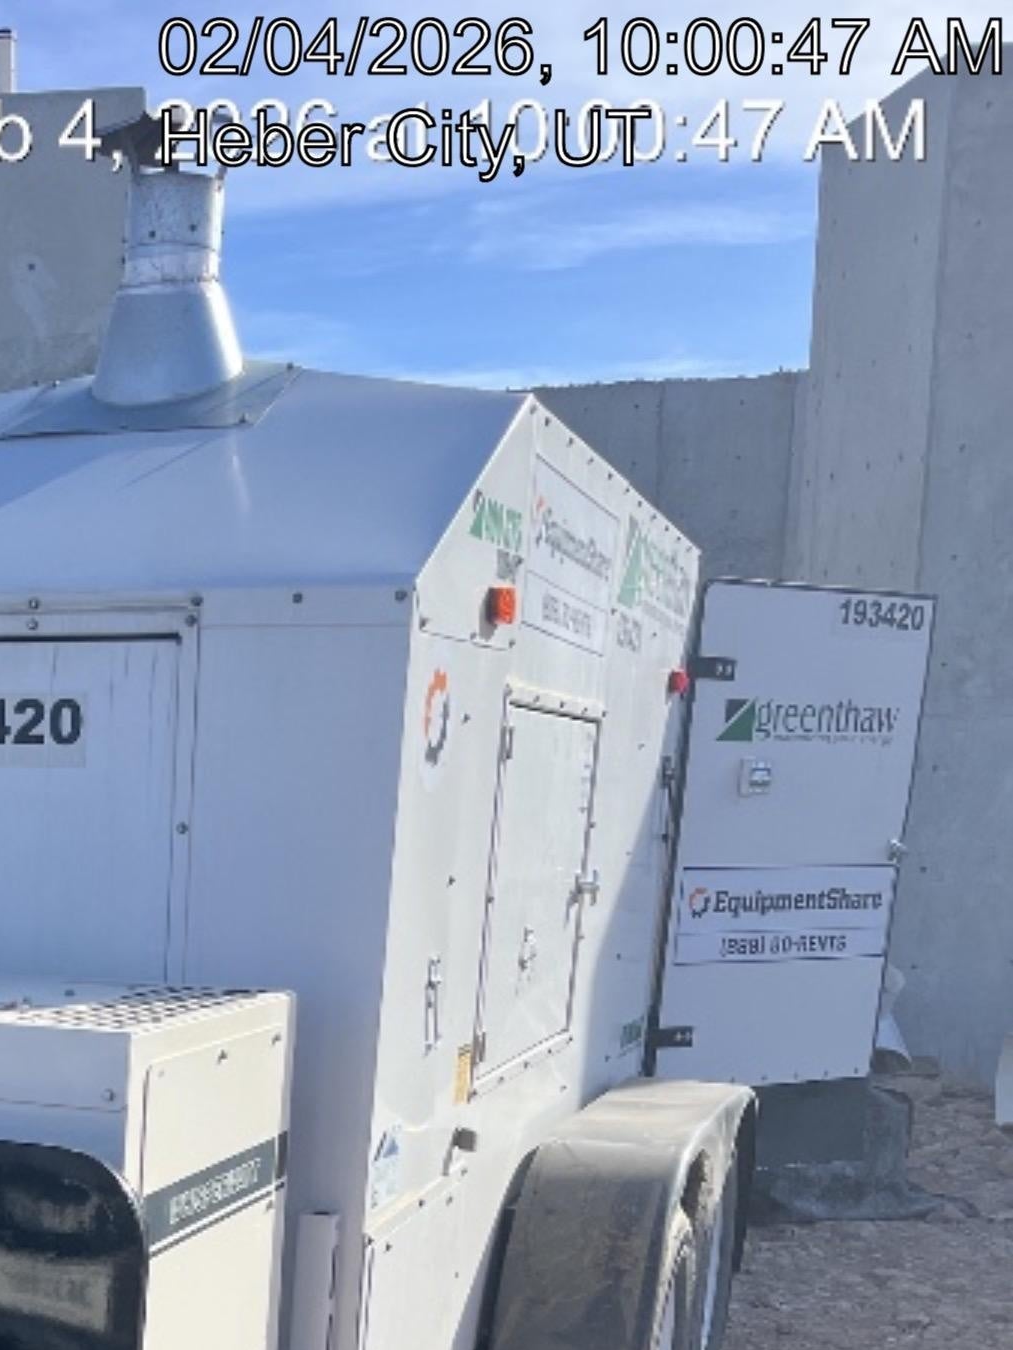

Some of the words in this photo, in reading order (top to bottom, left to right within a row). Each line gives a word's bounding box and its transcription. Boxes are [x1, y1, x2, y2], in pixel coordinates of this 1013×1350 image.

[840, 599, 925, 631] 193420
[754, 698, 900, 739] greenthaw
[712, 886, 883, 919] EquipmentShare
